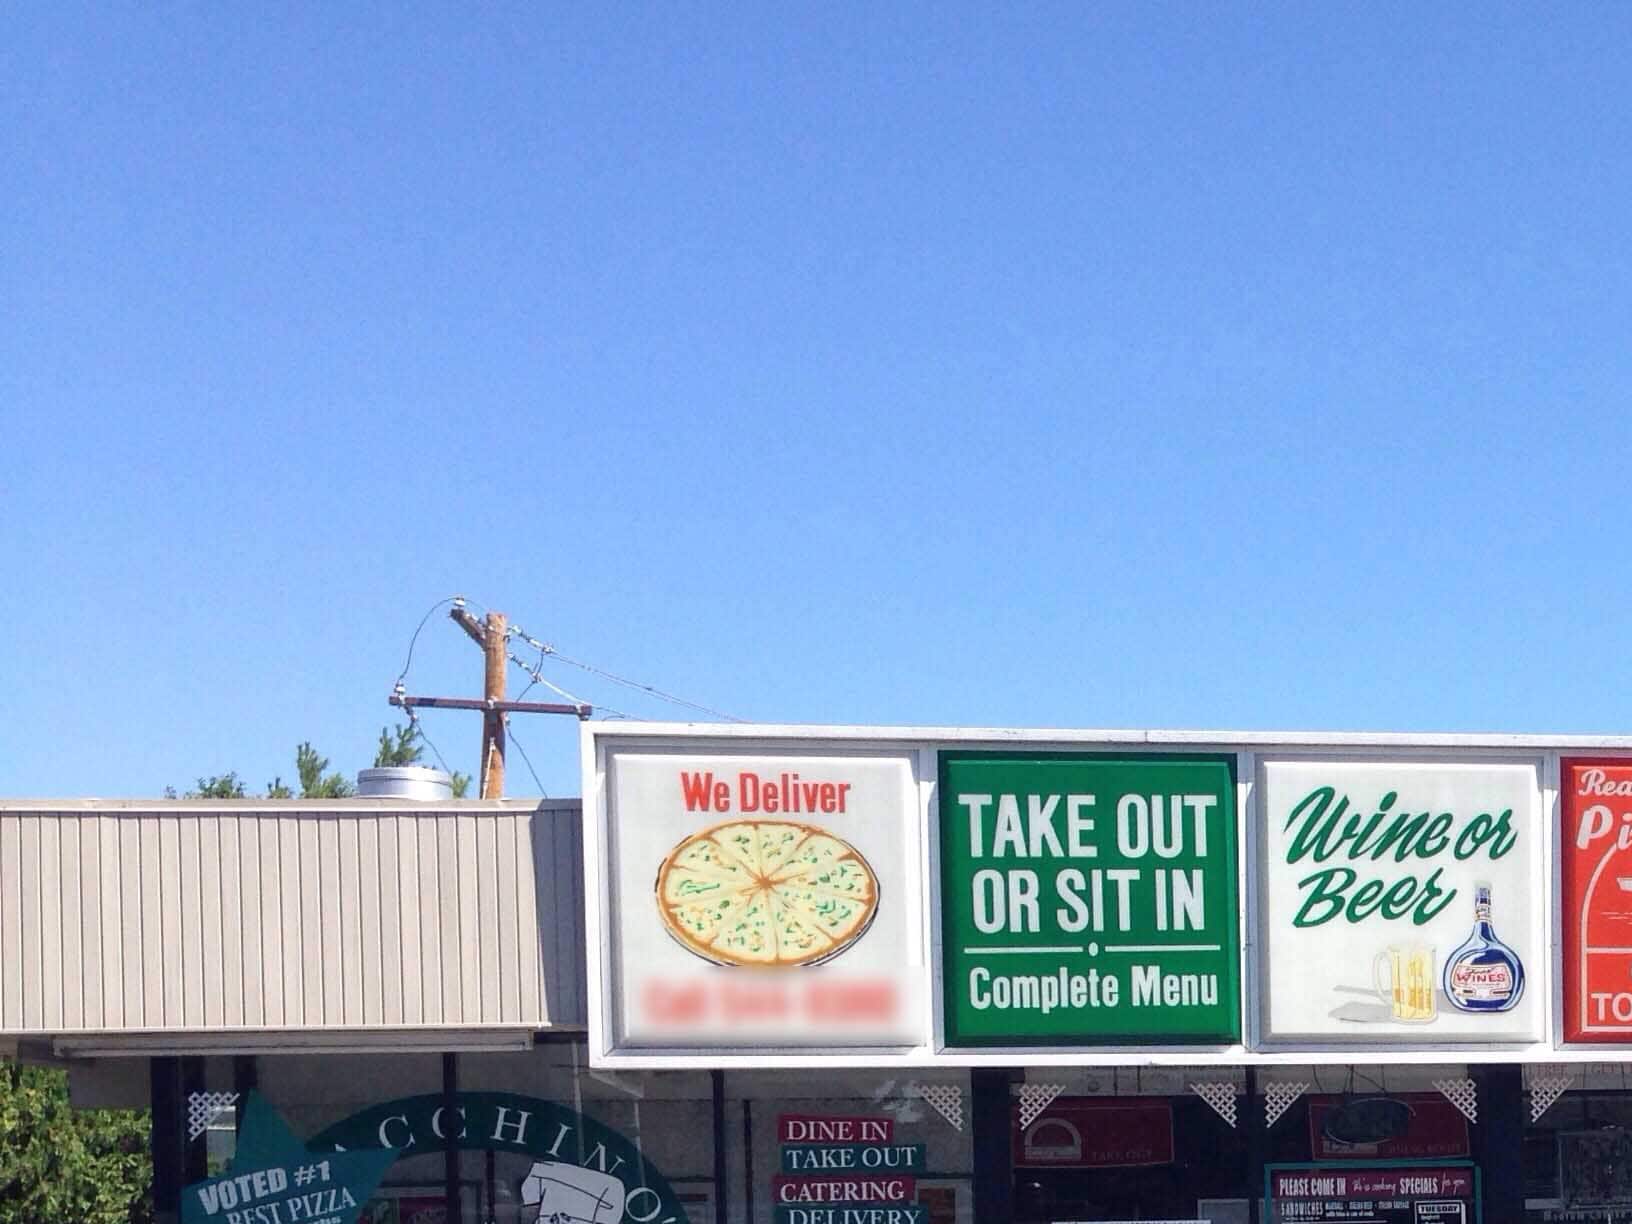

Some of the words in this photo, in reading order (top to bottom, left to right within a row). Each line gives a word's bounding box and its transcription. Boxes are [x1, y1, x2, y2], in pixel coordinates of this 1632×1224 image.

[681, 771, 730, 814] We
[740, 773, 851, 814] Deliver
[958, 793, 1096, 859] TAKE
[1116, 794, 1217, 859] OUT
[1283, 785, 1452, 865] Wine
[1453, 805, 1520, 862] or
[972, 869, 1041, 935] OR
[1057, 868, 1139, 934] SIT
[1155, 868, 1205, 932] IN
[1292, 866, 1457, 929] Beer
[969, 965, 1119, 1014] Complete
[1131, 967, 1218, 1008] Menu
[786, 1121, 852, 1142] DINE
[859, 1120, 889, 1141] IN
[786, 1148, 855, 1169] TAKE
[861, 1146, 917, 1167] OUT
[198, 1168, 288, 1216] VOTED
[293, 1160, 331, 1187] #1
[287, 1187, 357, 1223] PIZZA
[780, 1180, 905, 1203] CATERING
[1280, 1177, 1310, 1196] PLEASE
[1311, 1177, 1336, 1196] COME
[1400, 1177, 1438, 1195] SPECIALS
